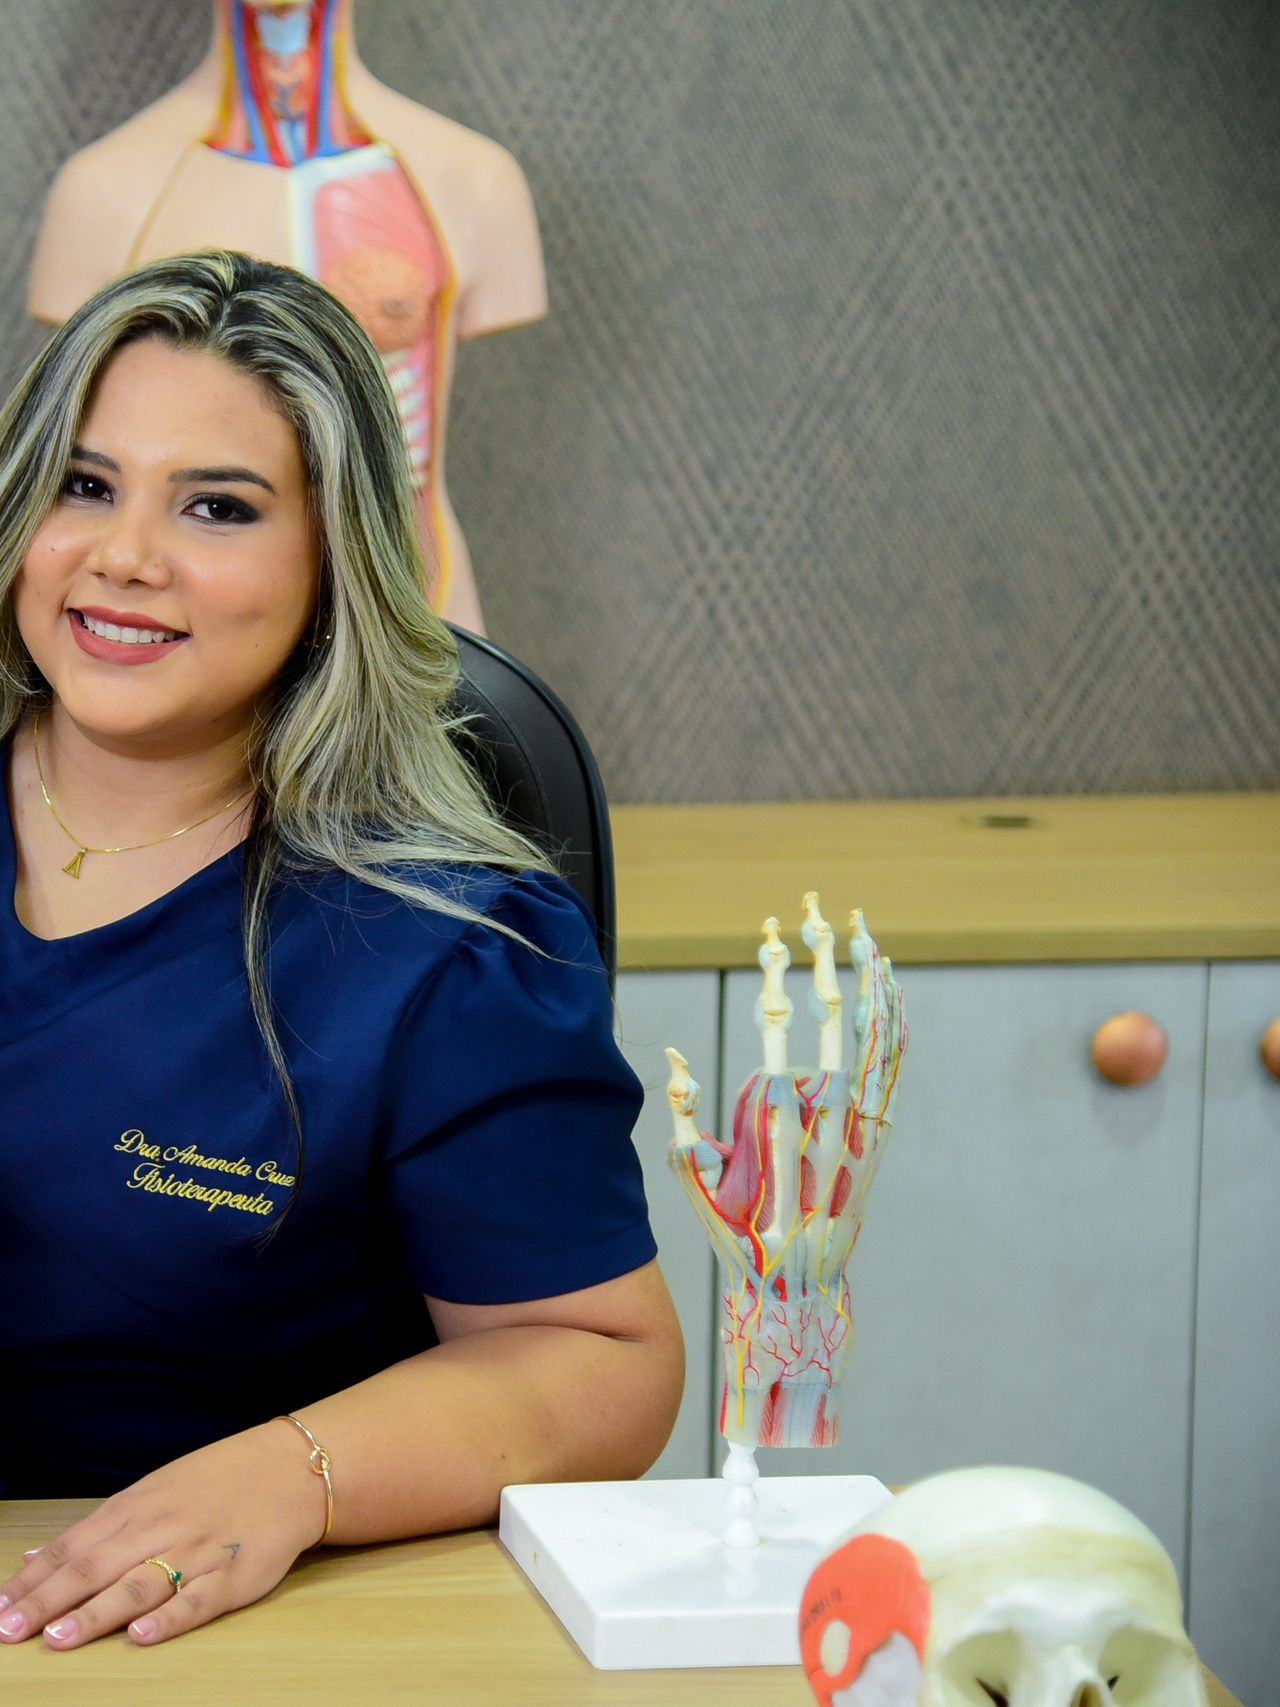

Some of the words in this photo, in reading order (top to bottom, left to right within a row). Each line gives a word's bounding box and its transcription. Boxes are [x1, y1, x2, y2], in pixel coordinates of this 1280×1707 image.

[126, 1162, 273, 1216] Fisioterapeuta
[163, 1144, 253, 1177] Amanda
[255, 1160, 296, 1187] Cruz
